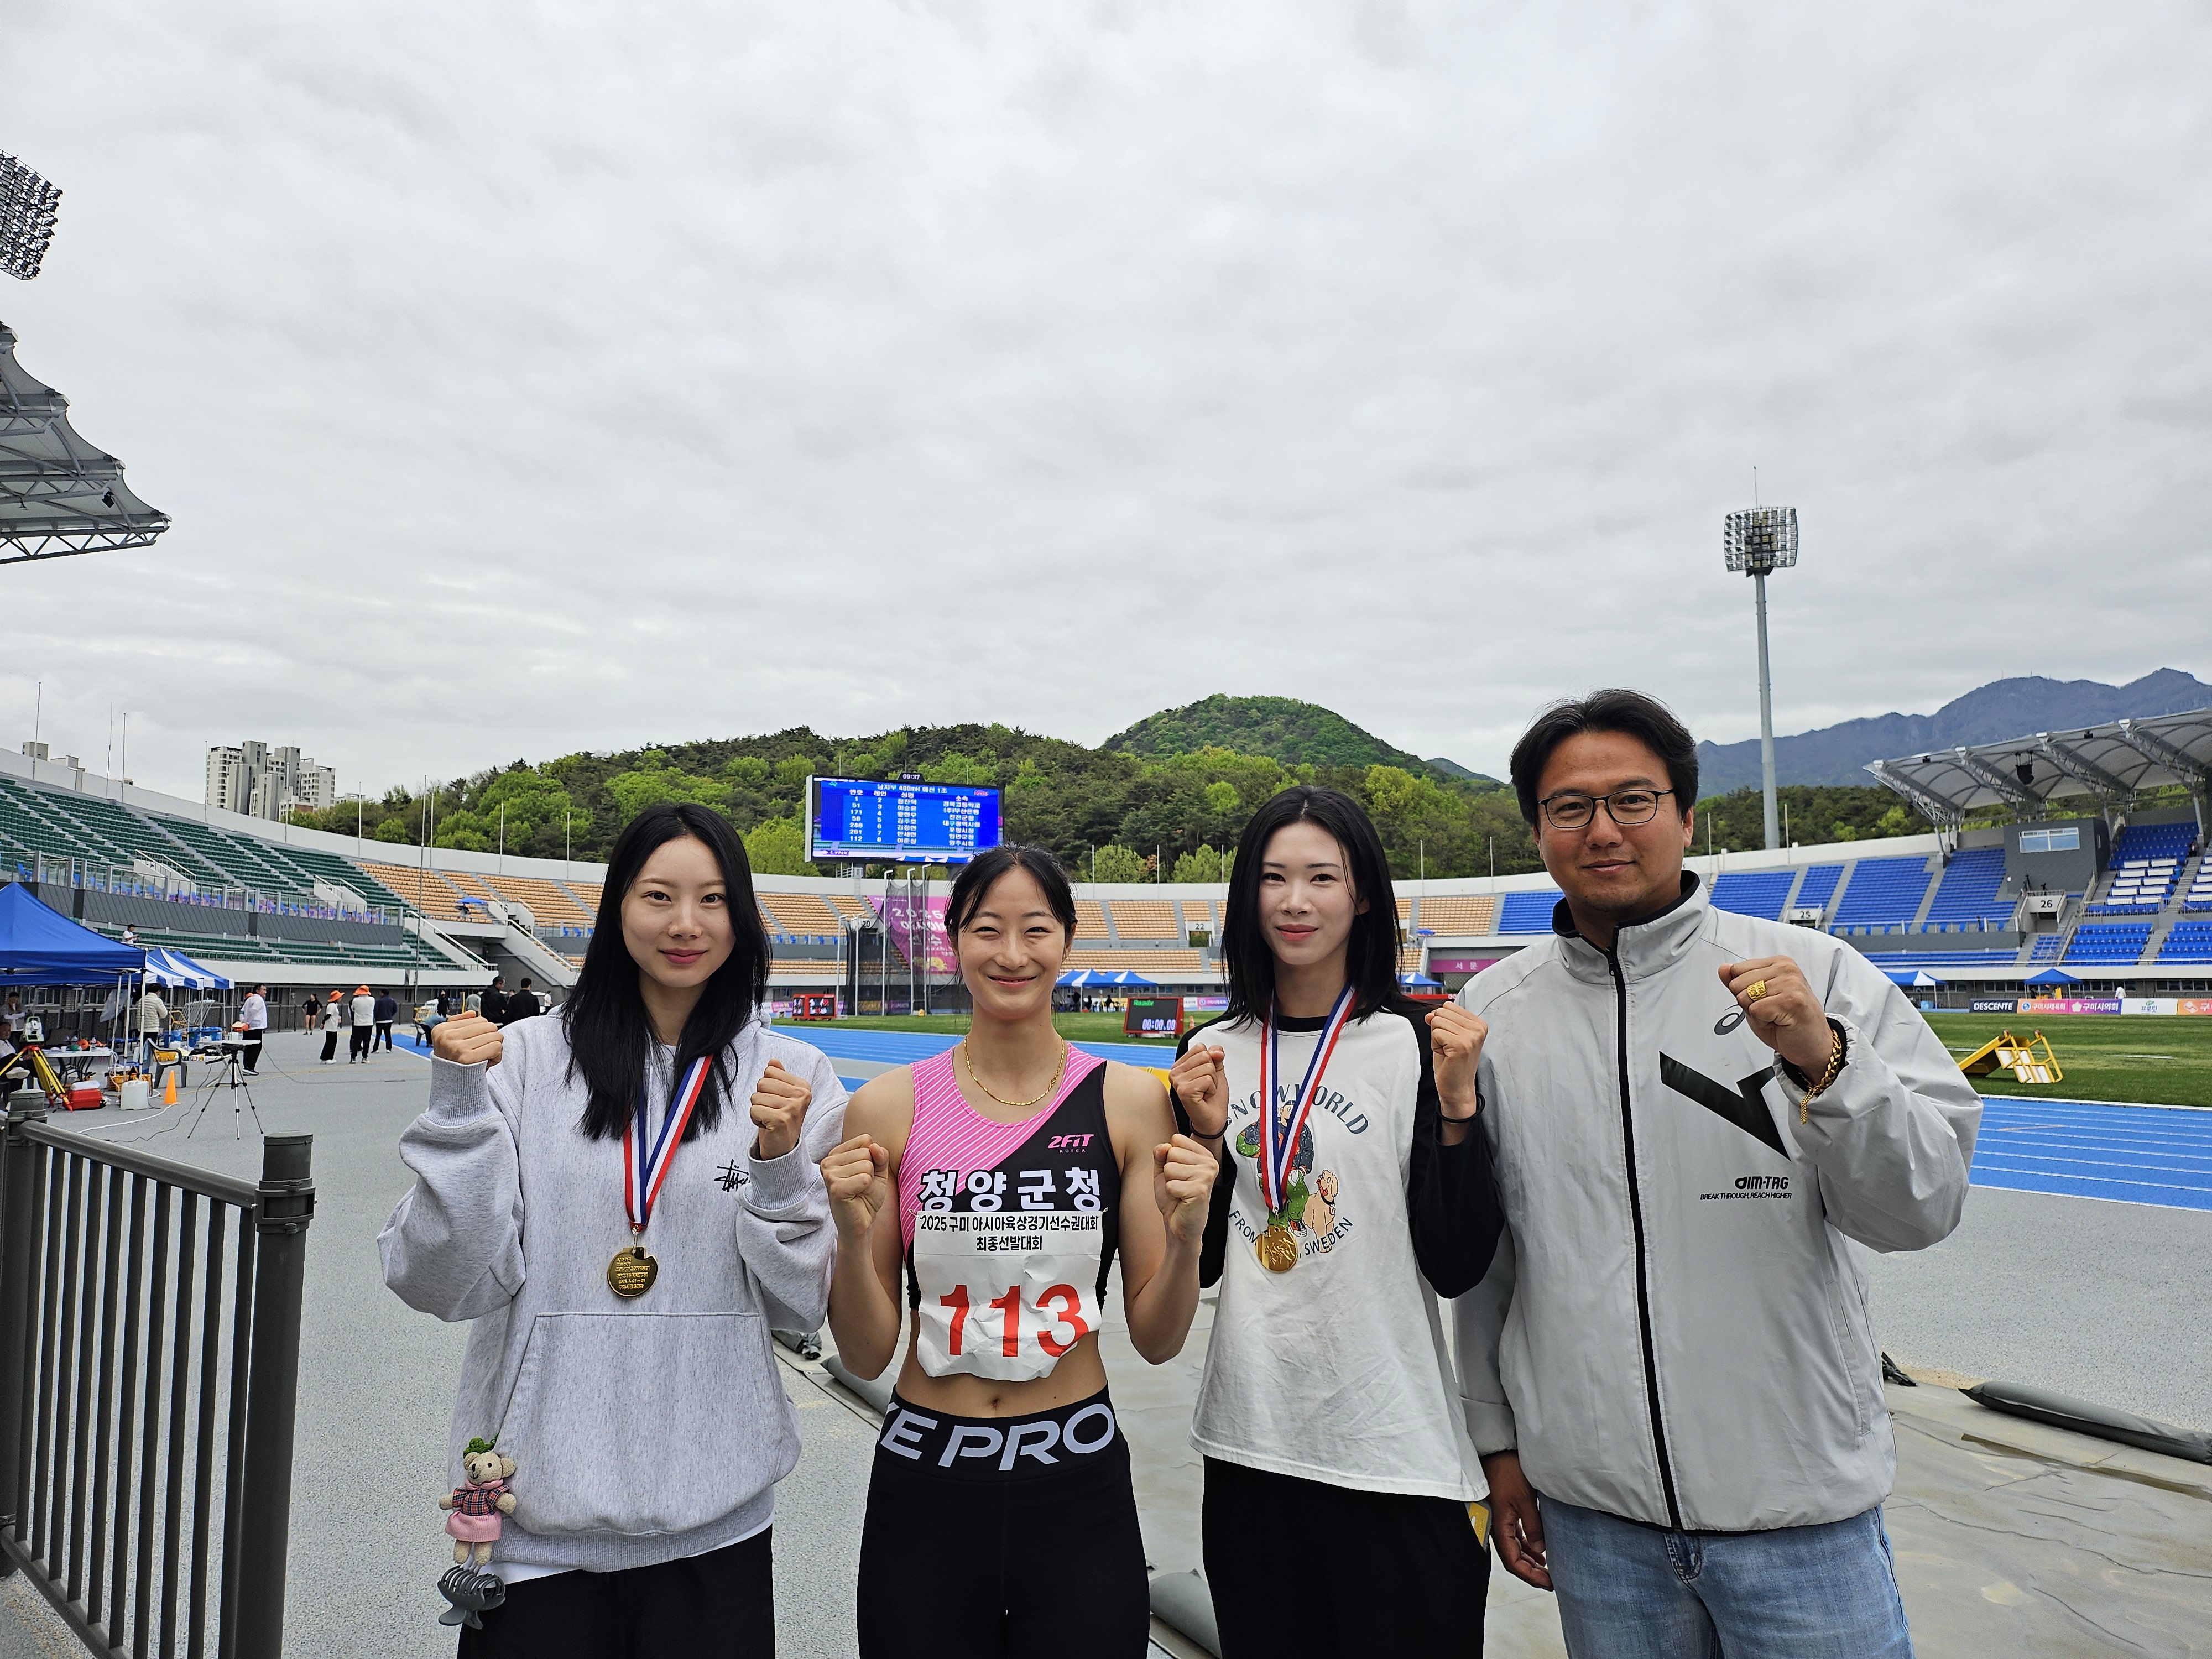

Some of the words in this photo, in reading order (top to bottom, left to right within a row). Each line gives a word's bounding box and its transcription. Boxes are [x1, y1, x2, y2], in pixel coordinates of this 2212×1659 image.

[2041, 900, 2052, 908] 26
[892, 908, 943, 920] 2025
[1974, 1001, 2013, 1010] DESCENTE
[2032, 1002, 2065, 1010] 구미시체육회
[2083, 1002, 2119, 1011] 구미시의회
[1295, 1083, 1368, 1134] ORLD
[919, 1167, 1101, 1212] 청양군청
[920, 1215, 947, 1232] 2025
[948, 1216, 969, 1233] 구미
[972, 1215, 1099, 1232] 아시아육상경기선수권대회
[976, 1235, 1042, 1251] 최종선발대회
[1304, 1216, 1354, 1256] SWEDEN
[940, 1284, 1089, 1358] 113
[881, 1401, 938, 1460] E
[937, 1402, 1115, 1471] PRO
